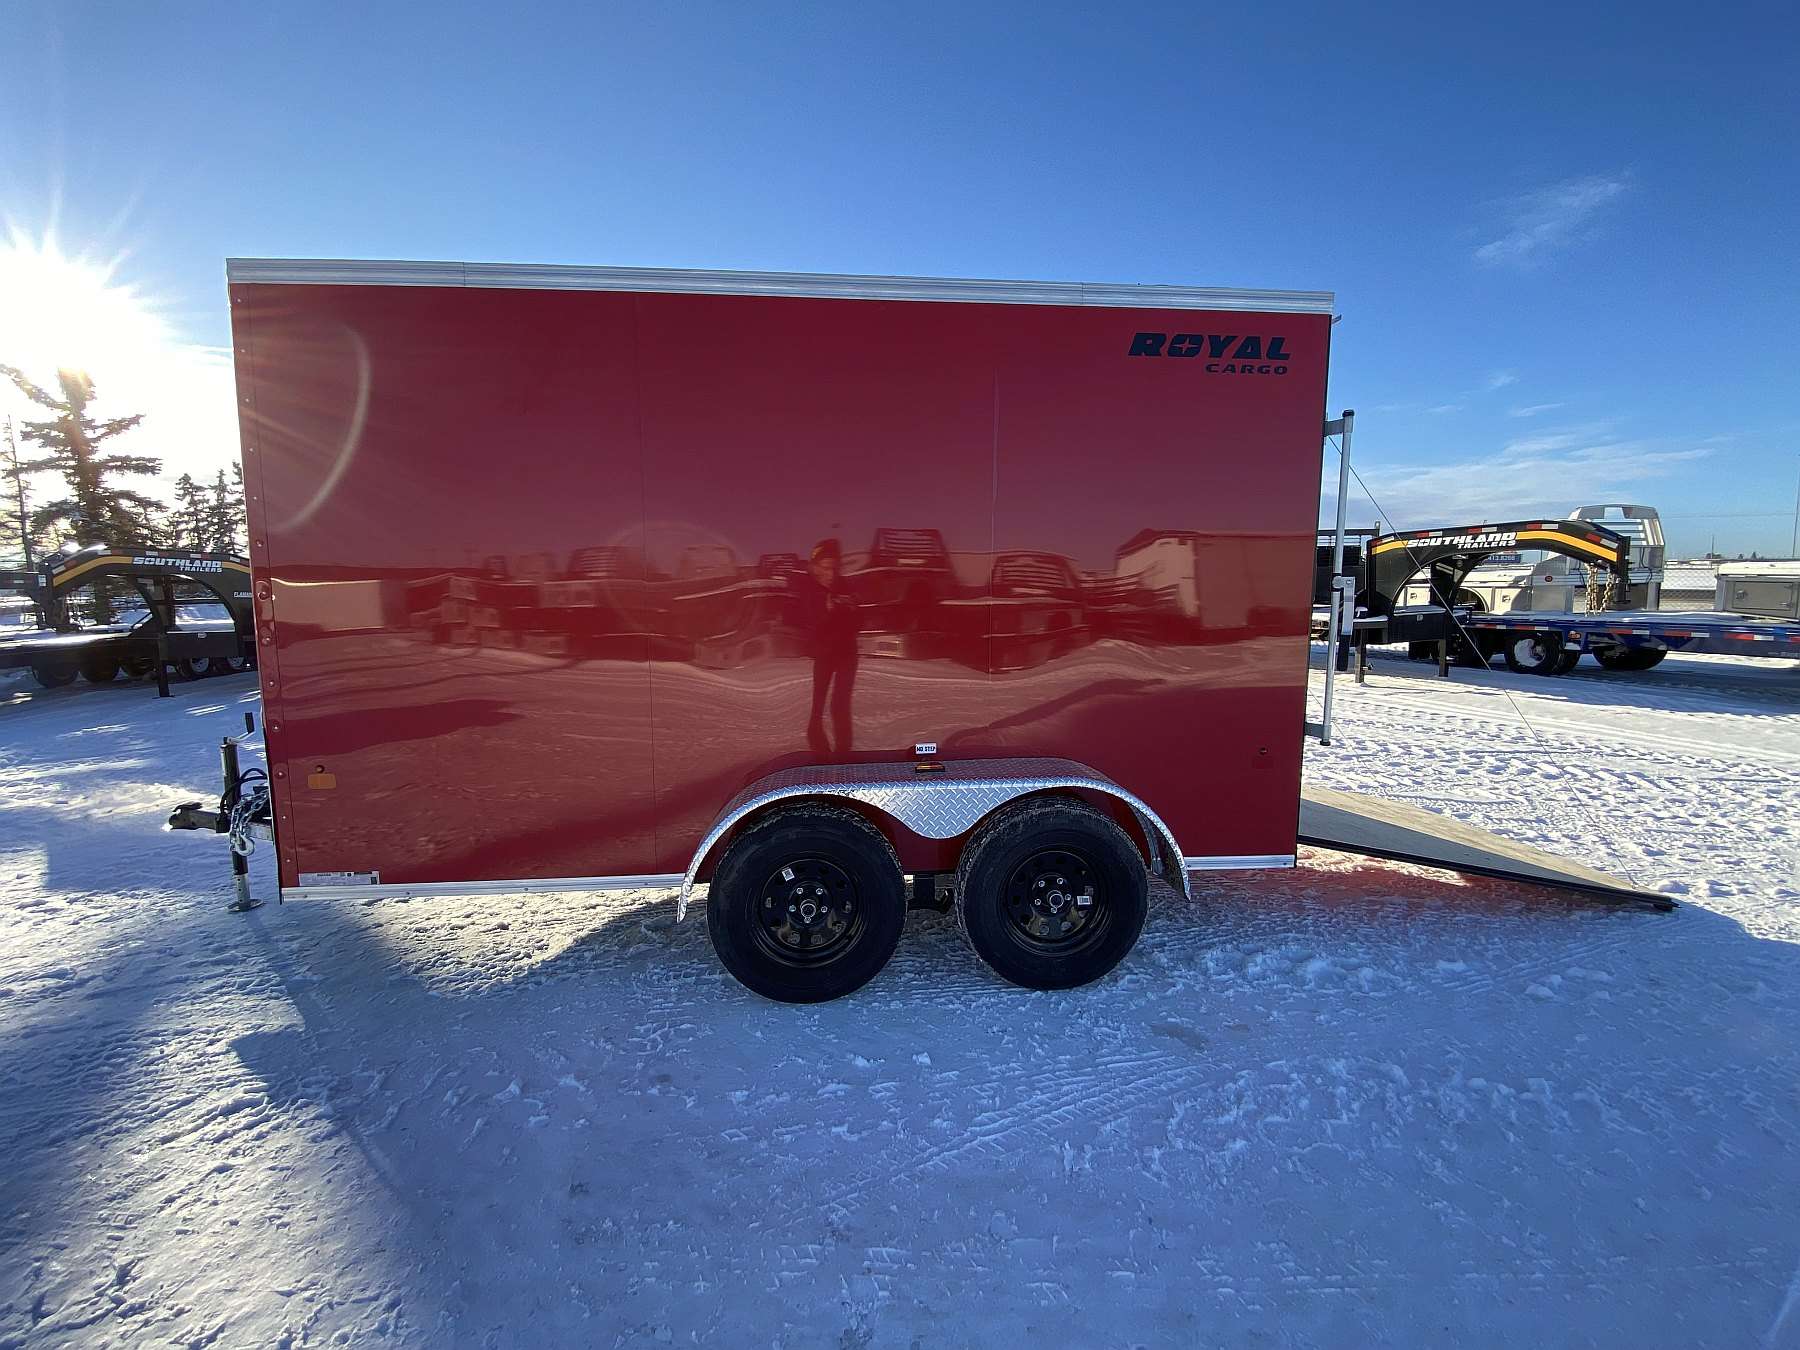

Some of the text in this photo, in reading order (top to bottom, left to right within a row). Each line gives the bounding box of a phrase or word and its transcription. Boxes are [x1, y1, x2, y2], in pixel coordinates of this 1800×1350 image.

[1128, 332, 1291, 360] ROYAL
[1205, 363, 1288, 375] CARGO
[1406, 532, 1517, 548] SOUTHLAND
[1457, 540, 1516, 549] TRAILERS
[133, 556, 222, 568] SOUTHLAND
